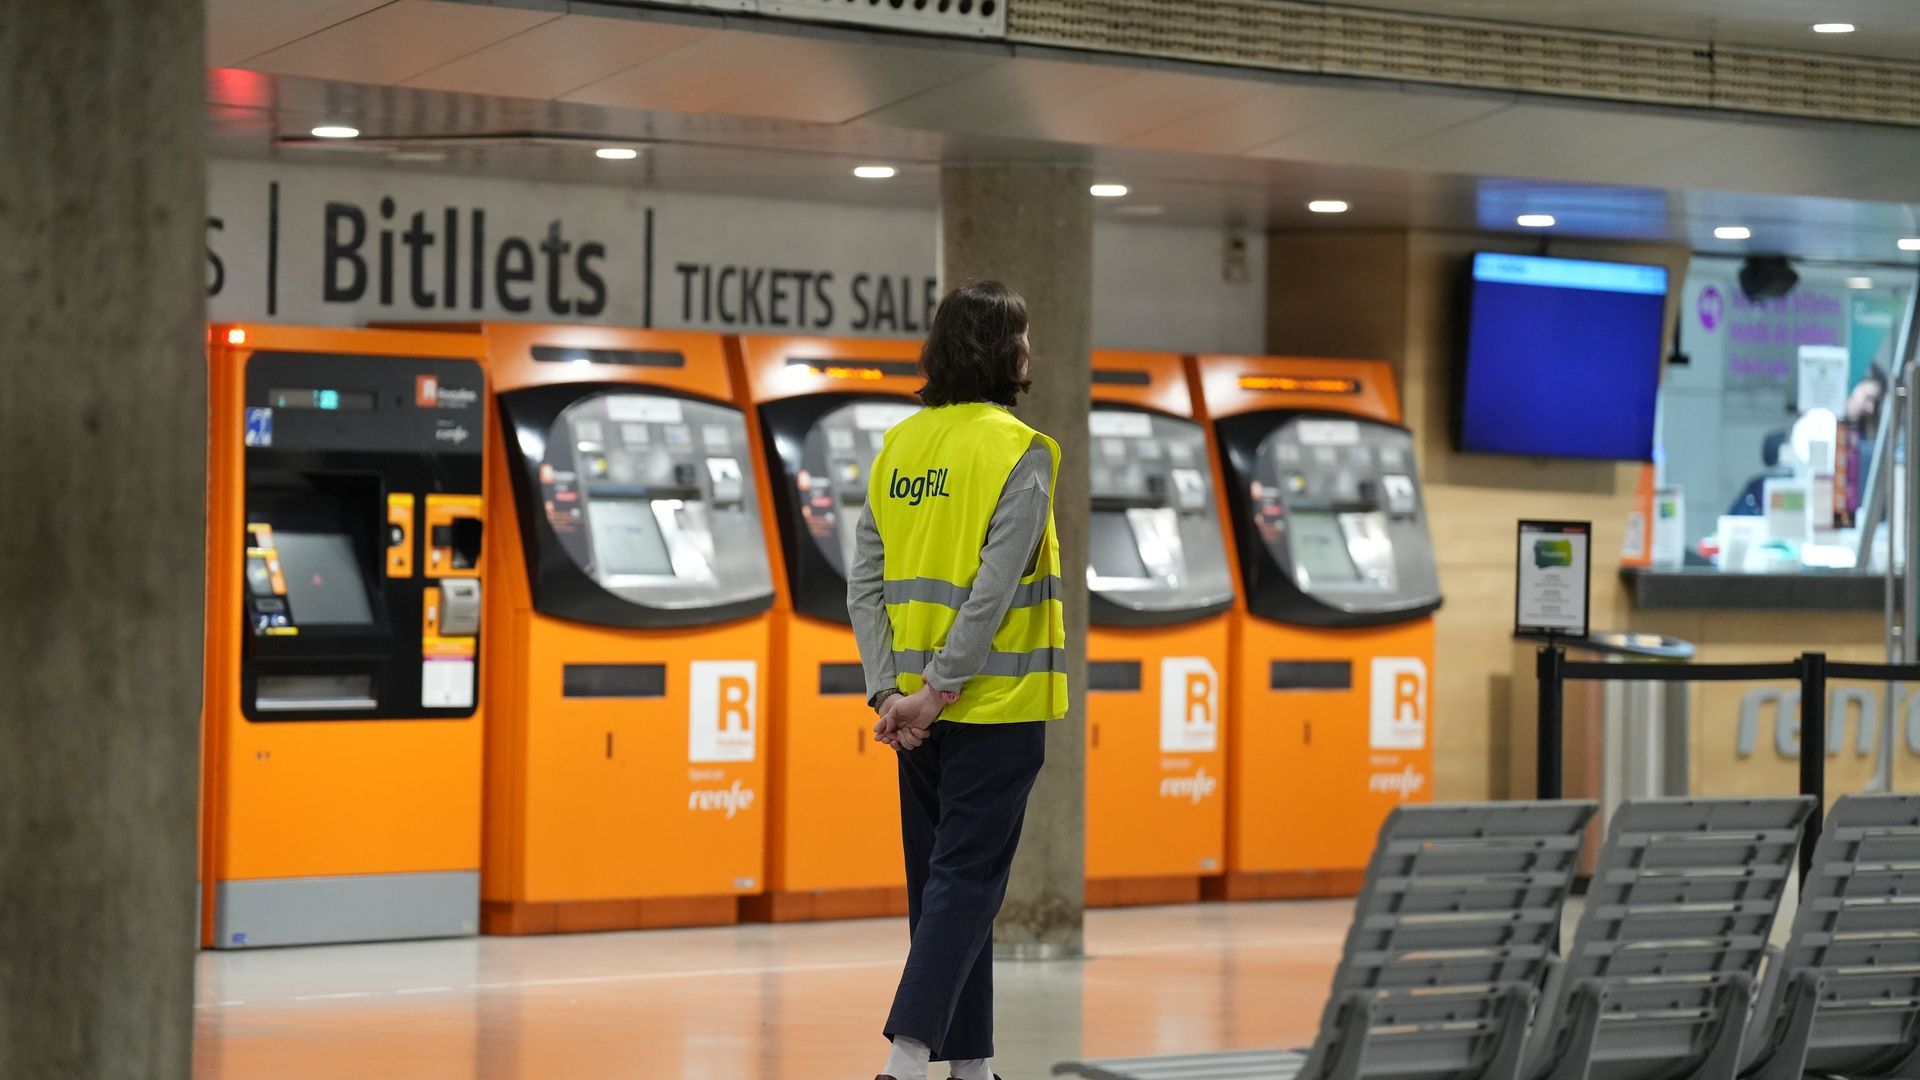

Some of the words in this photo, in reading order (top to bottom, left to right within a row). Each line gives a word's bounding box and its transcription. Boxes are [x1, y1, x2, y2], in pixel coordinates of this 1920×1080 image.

[322, 195, 608, 316] Bitllets
[675, 262, 835, 329] TICKETS
[718, 676, 750, 731] R
[1185, 671, 1212, 722] R
[1394, 671, 1420, 721] R
[688, 778, 755, 819] renfe
[1159, 768, 1217, 805] renfe
[1368, 764, 1424, 800] renfe
